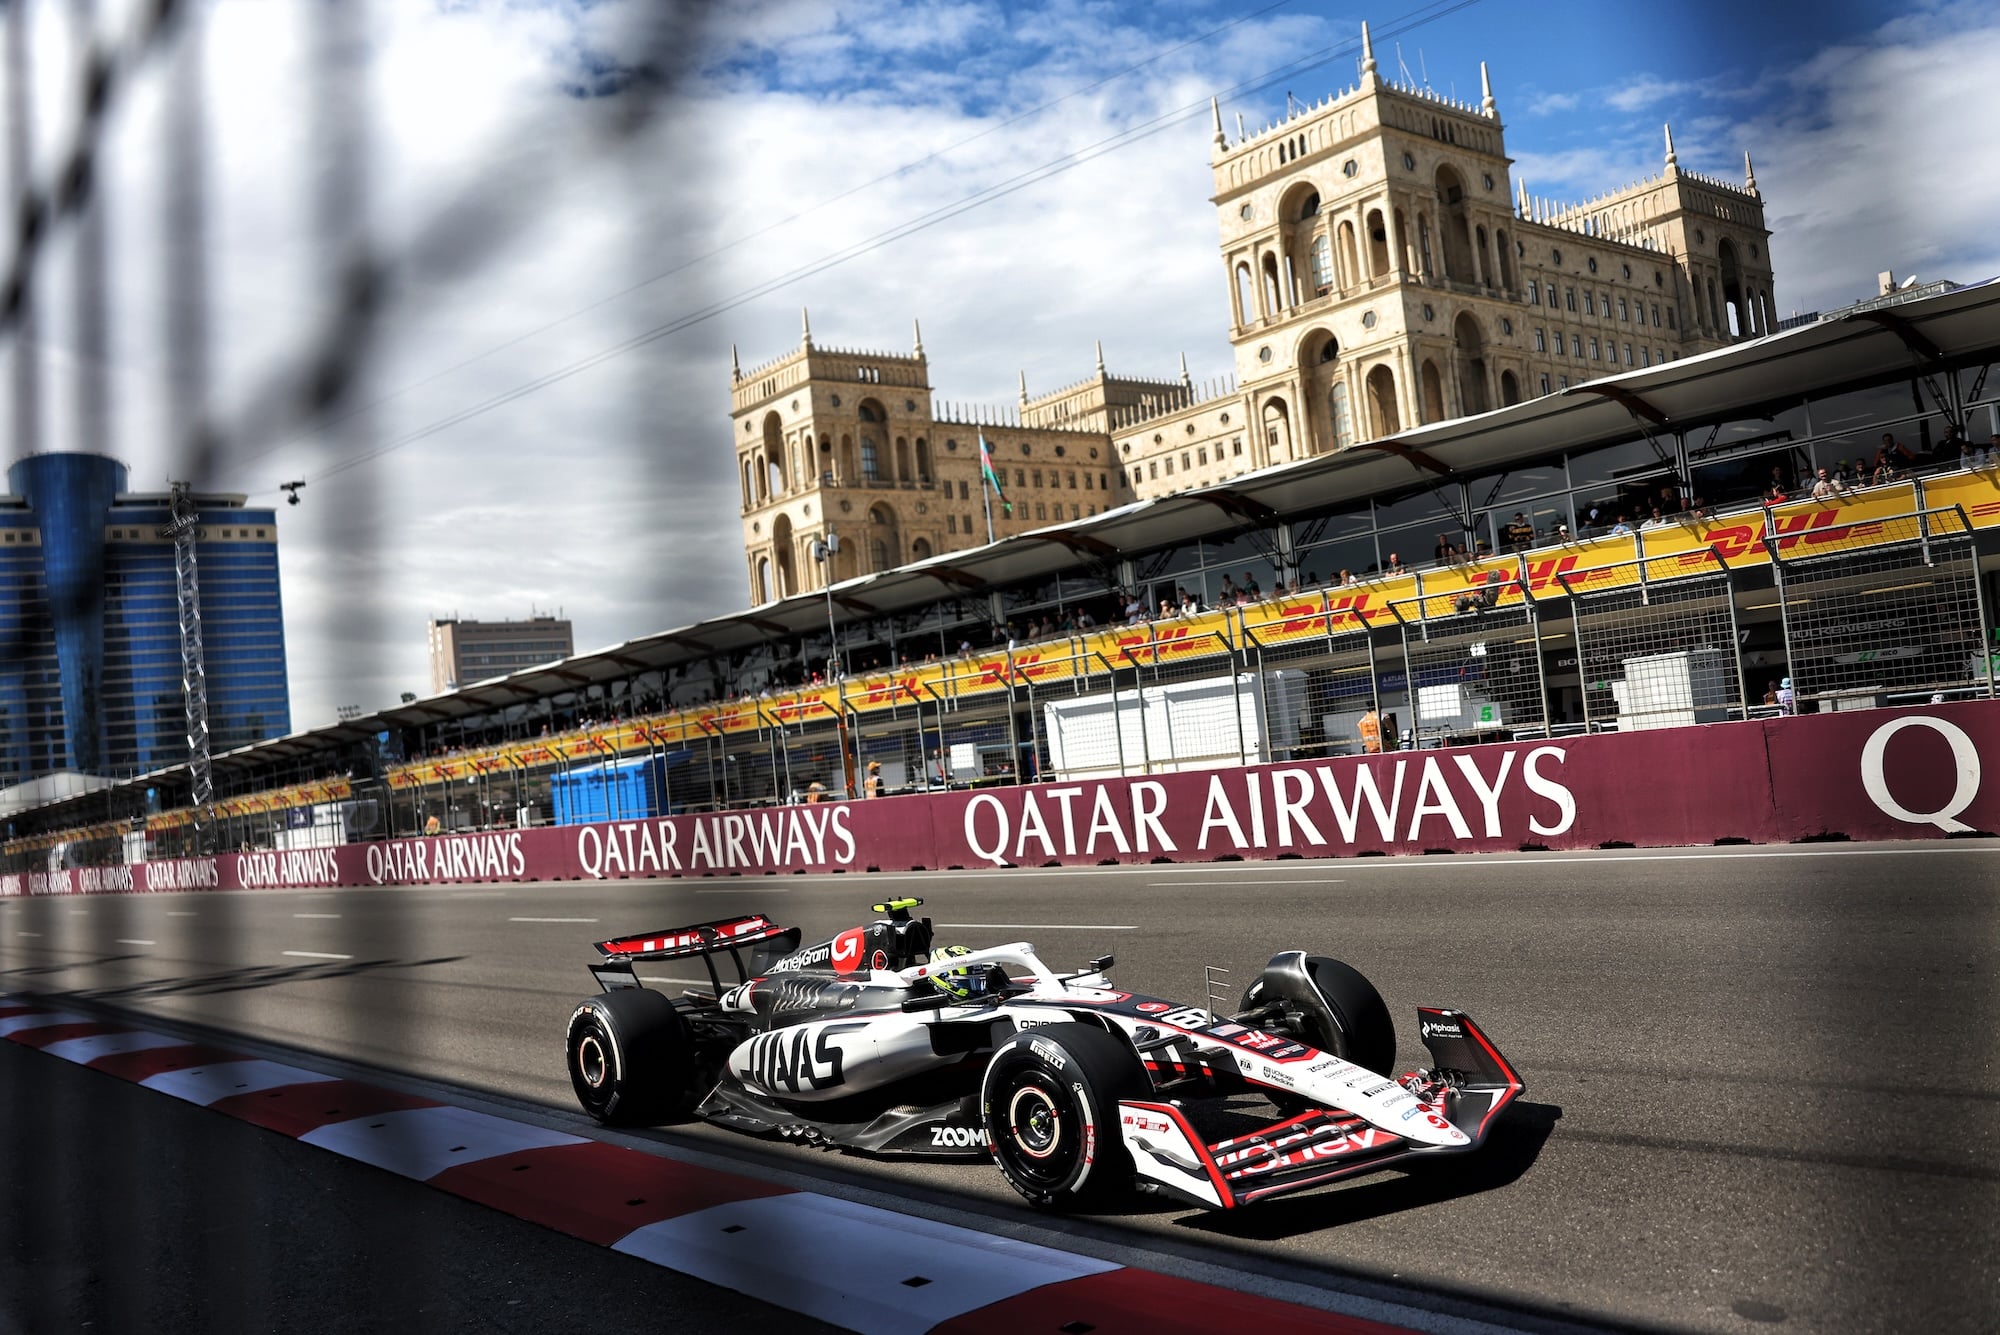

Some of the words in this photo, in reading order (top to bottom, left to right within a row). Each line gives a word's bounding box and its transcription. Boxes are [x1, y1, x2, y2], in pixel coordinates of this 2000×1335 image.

[1704, 509, 1851, 562] DHL
[1470, 556, 1588, 597] DHL
[1281, 594, 1379, 633] DHL
[1117, 628, 1197, 660] DHL
[980, 654, 1045, 684] DHL
[868, 678, 925, 704] DHL
[702, 711, 742, 731] DHL
[779, 695, 826, 718] DHL
[1480, 706, 1493, 722] 5
[633, 723, 668, 743] DHL
[1860, 715, 1981, 832] Q
[964, 780, 1177, 865] QATAR
[1197, 746, 1577, 850] AIRWAYS
[578, 820, 681, 879] QATAR
[691, 805, 855, 869] AIRWAYS
[237, 854, 278, 889] QATAR
[280, 848, 338, 883] AIRWAYS
[367, 841, 430, 884] QATAR
[434, 833, 525, 878] AIRWAYS
[79, 867, 102, 894] QATAR
[102, 865, 133, 892] AIRWAYS
[146, 861, 176, 892] QATAR
[176, 858, 218, 888] AIRWAYS
[774, 946, 829, 971] MoneyGram
[1020, 1020, 1053, 1029] ORIO
[1430, 1022, 1460, 1033] Mphasis
[741, 1022, 872, 1094] HAAS
[1030, 1040, 1066, 1070] PIRELLI
[1362, 1081, 1399, 1098] PIRELLI
